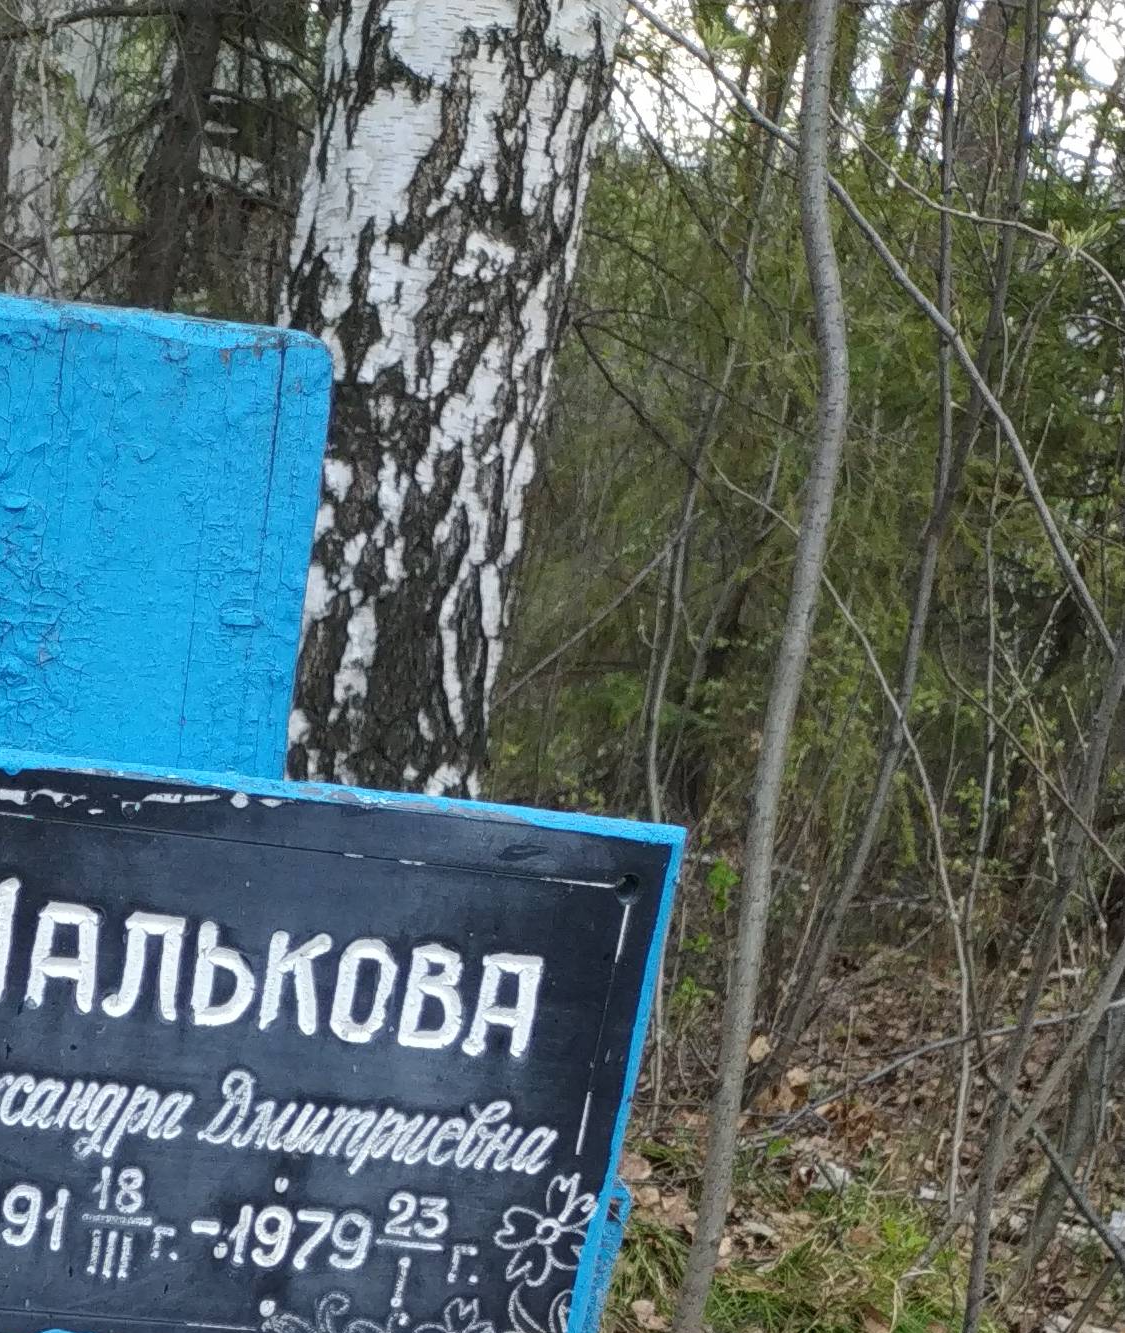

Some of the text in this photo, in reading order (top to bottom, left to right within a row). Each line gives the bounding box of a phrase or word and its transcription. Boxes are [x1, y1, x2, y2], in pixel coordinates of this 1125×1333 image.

[197, 1069, 559, 1175] Дмитриевна
[92, 1165, 145, 1214] 18
[383, 1190, 450, 1239] 23
